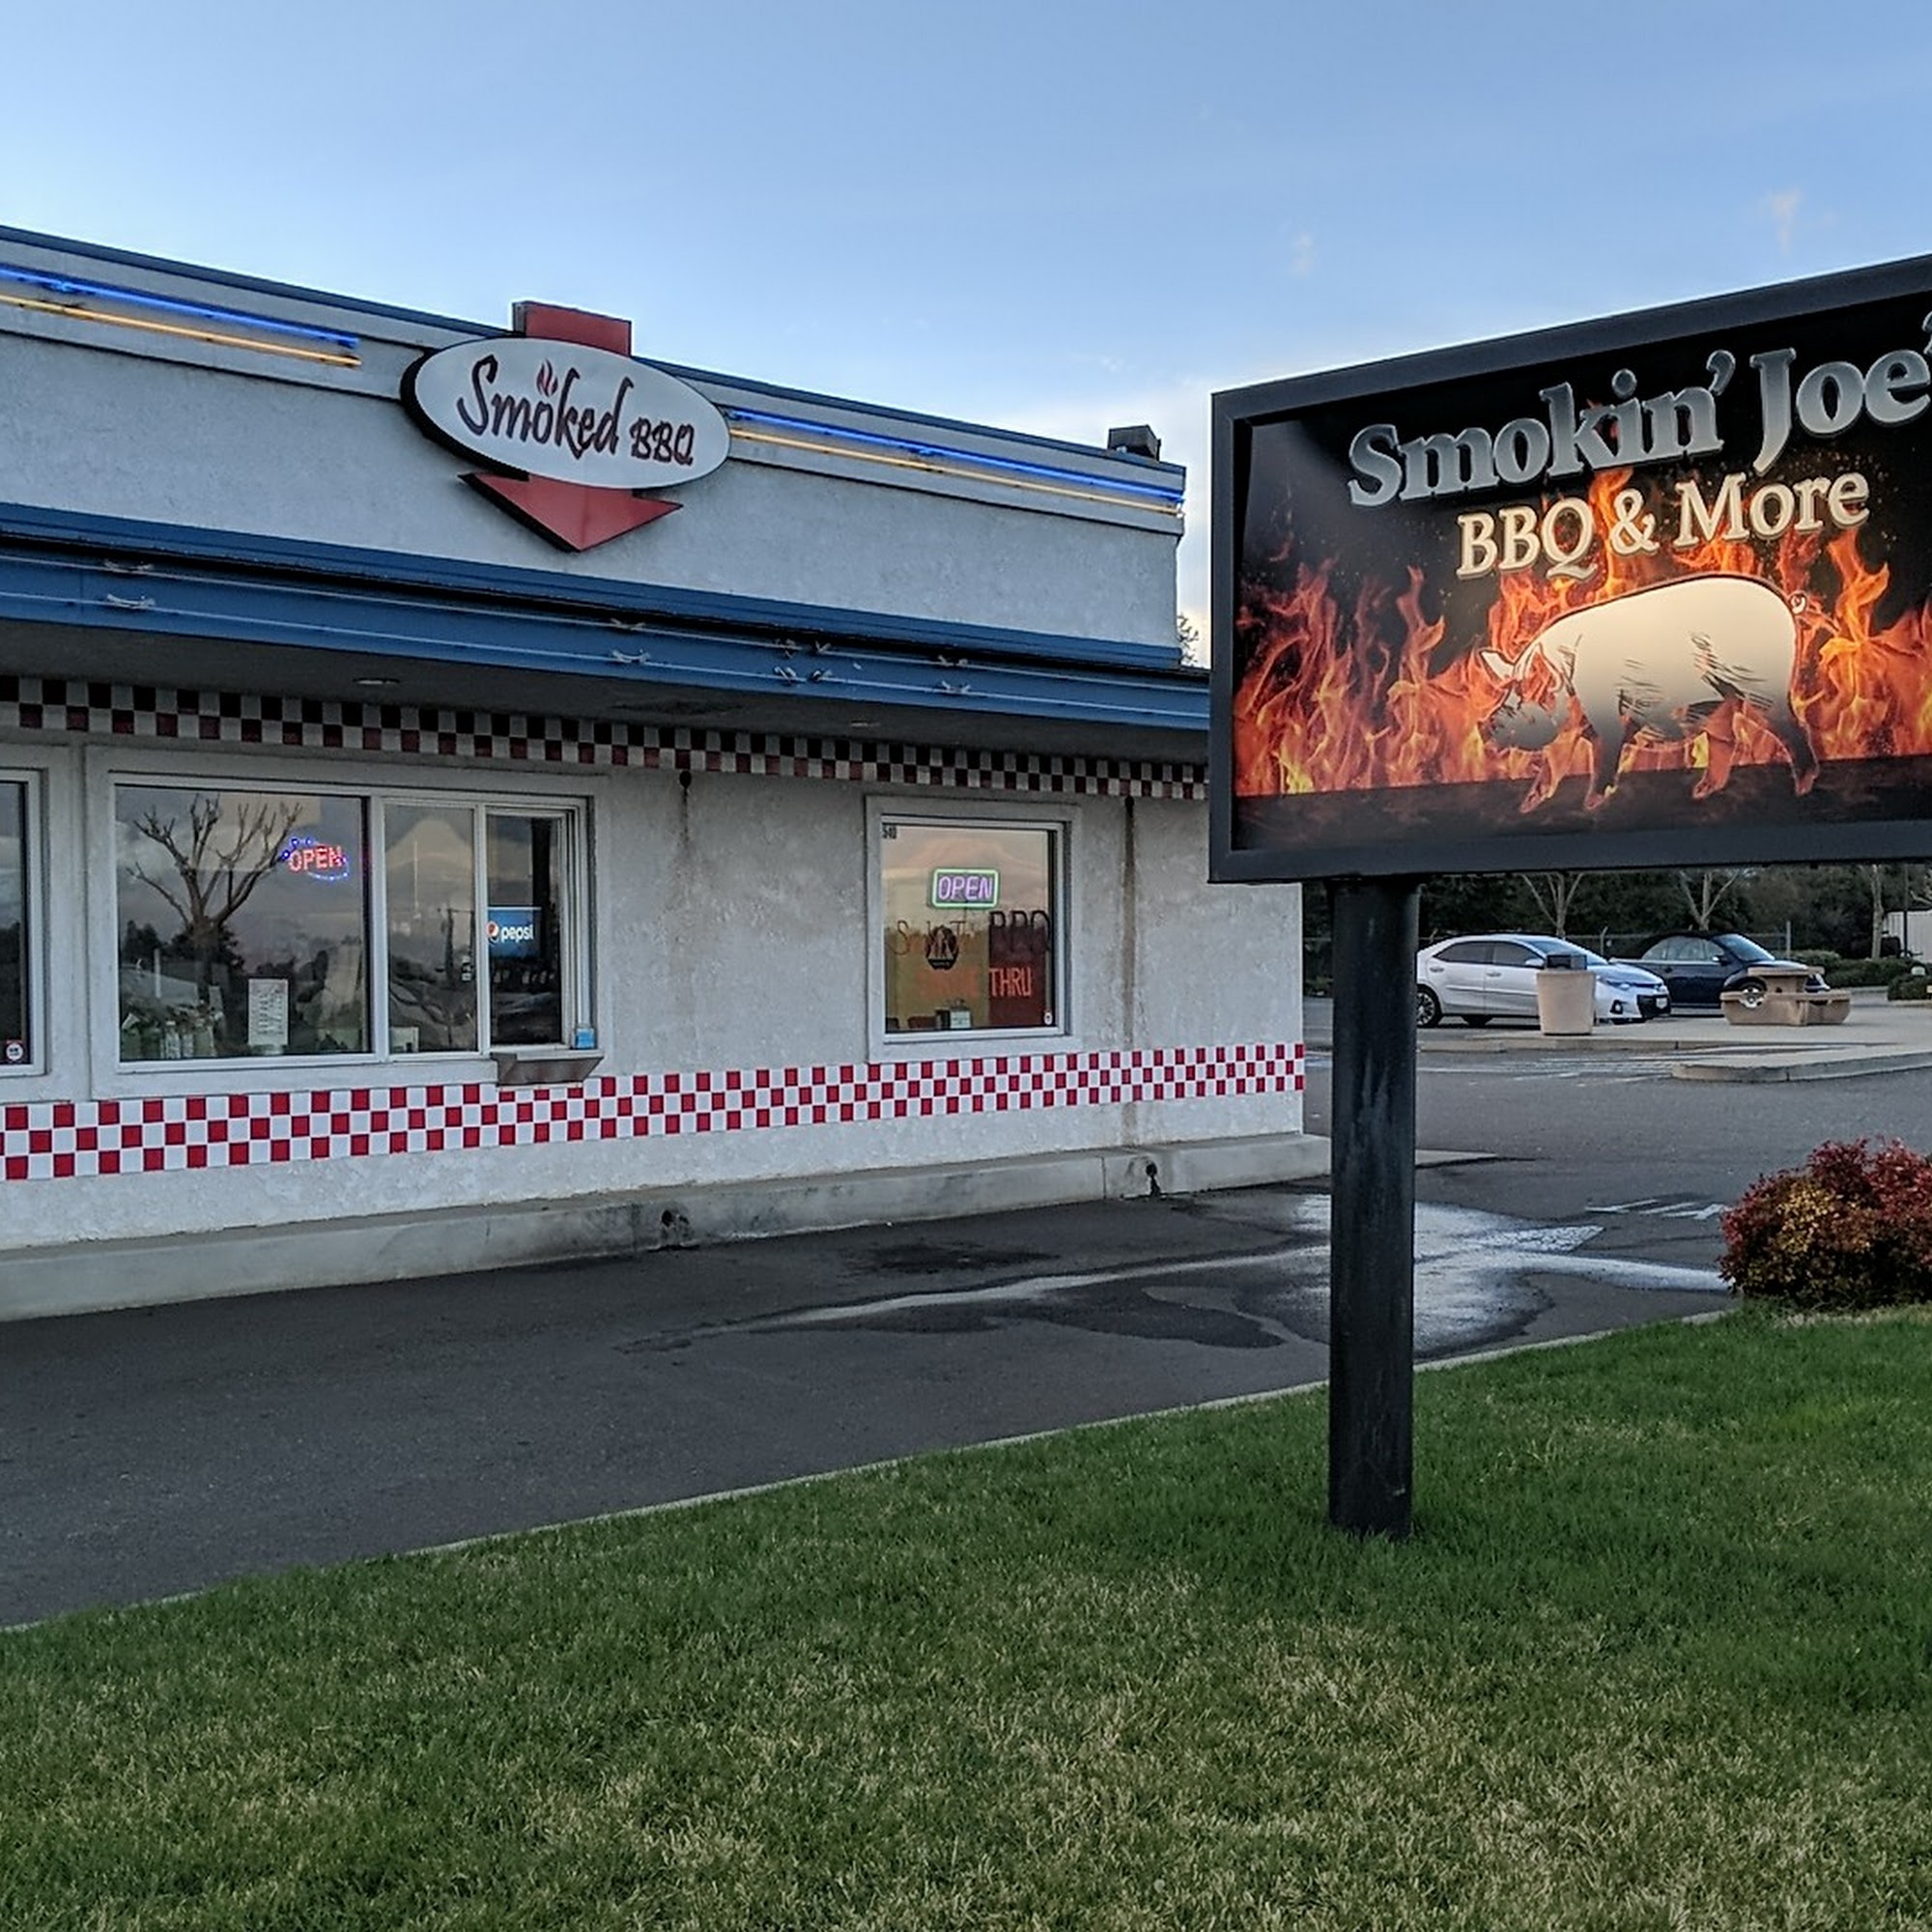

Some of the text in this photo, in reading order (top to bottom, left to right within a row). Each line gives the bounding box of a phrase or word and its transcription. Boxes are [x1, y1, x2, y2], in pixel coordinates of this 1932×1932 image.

[457, 354, 696, 466] Smoked BBQ
[1349, 350, 1736, 507] Smokin'
[1456, 471, 1870, 580] BBQ & More
[289, 844, 344, 872] OPEN
[938, 875, 993, 900] OPEN
[500, 923, 533, 944] pepsi
[989, 967, 1032, 997] THRU
